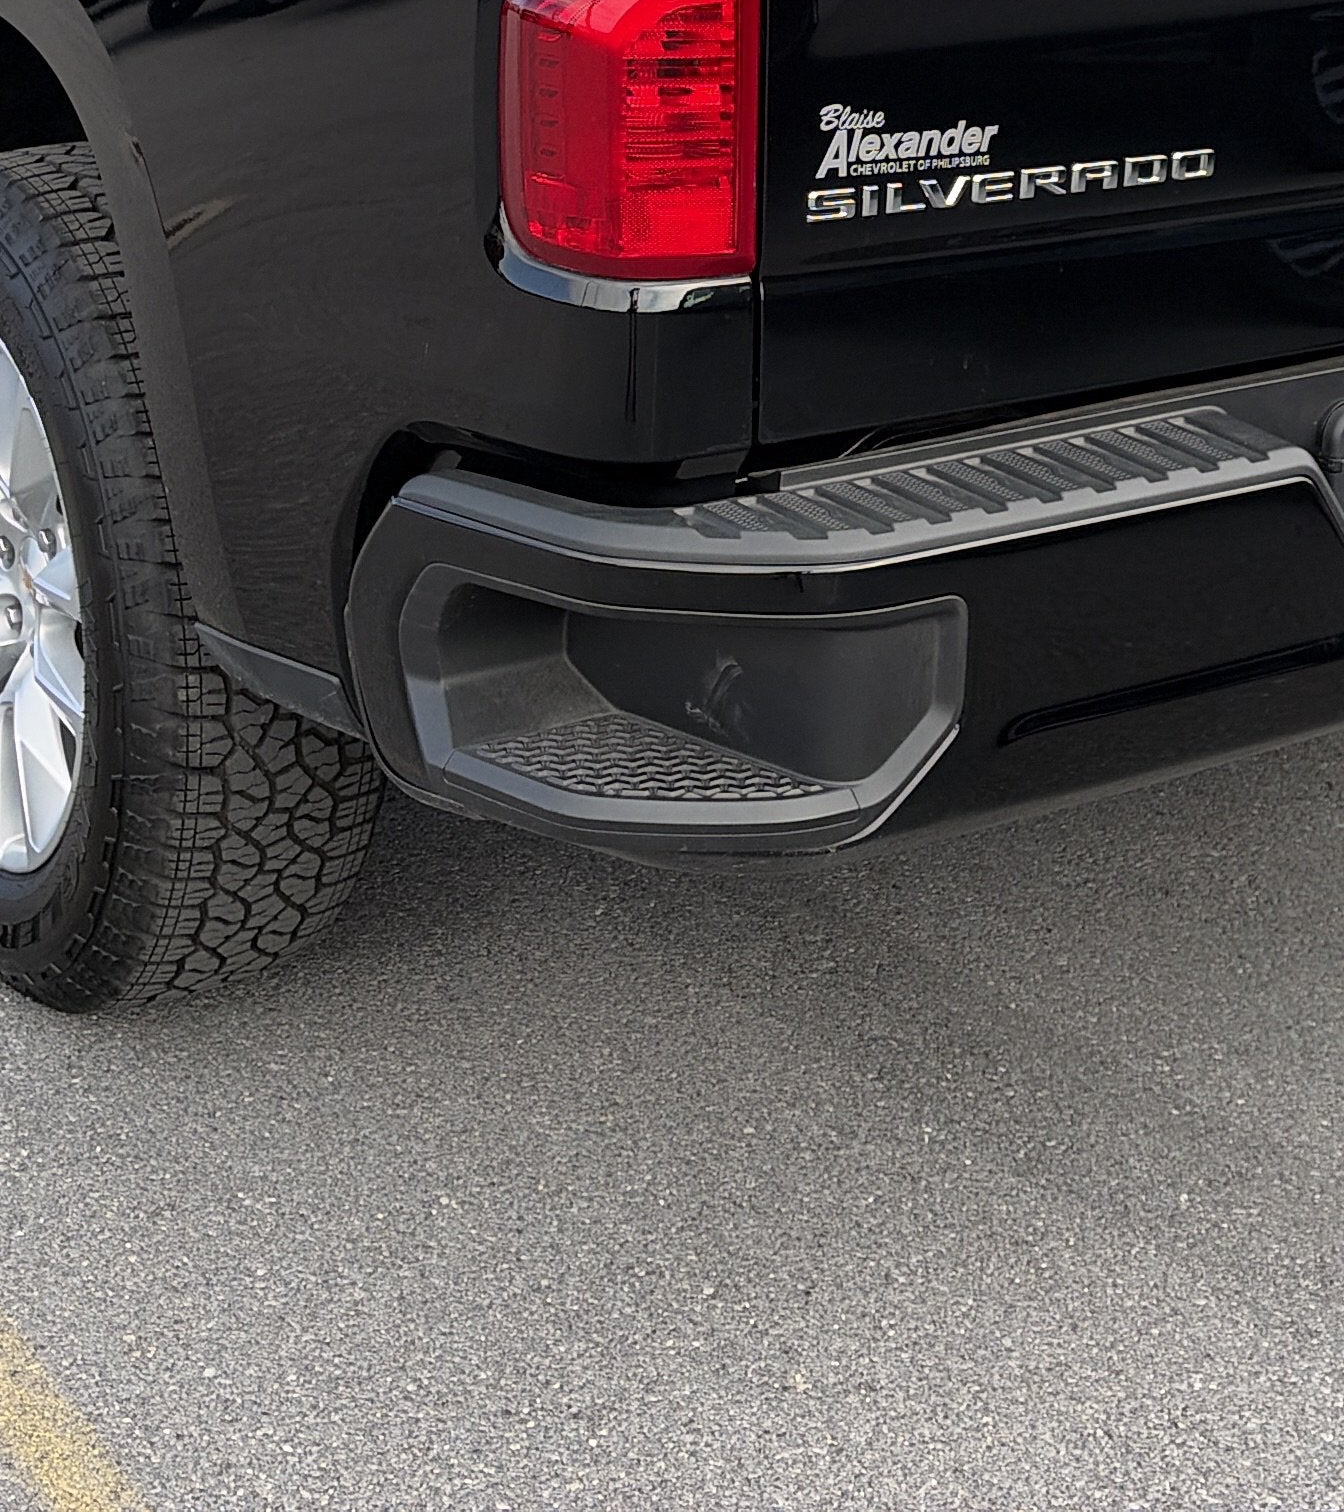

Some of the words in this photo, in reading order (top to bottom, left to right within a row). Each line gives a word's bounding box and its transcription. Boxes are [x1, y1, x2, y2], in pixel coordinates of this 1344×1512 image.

[819, 103, 886, 131] Blaise
[815, 119, 999, 179] Alexander
[850, 160, 915, 176] CHEVROLET
[917, 159, 931, 171] OF
[931, 155, 990, 170] PHILIPSBURG
[806, 148, 1216, 223] SILVERADO
